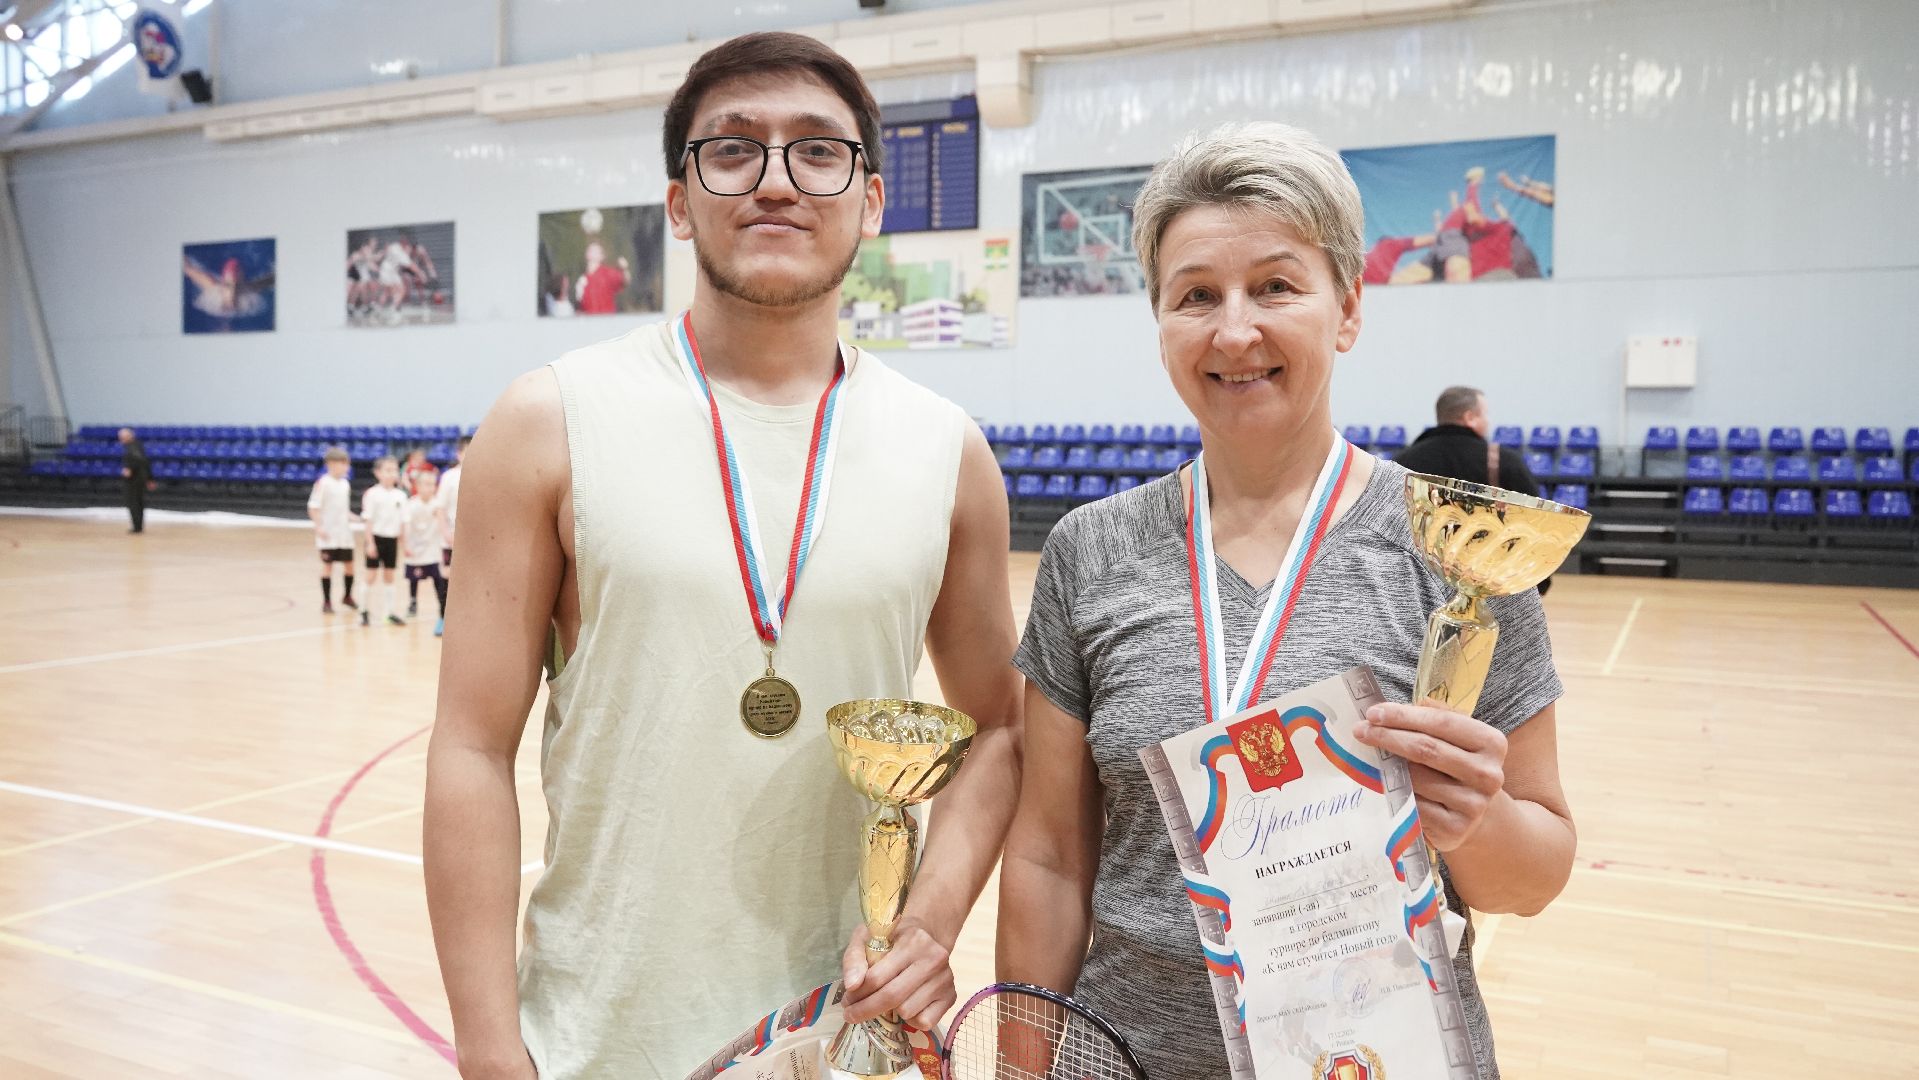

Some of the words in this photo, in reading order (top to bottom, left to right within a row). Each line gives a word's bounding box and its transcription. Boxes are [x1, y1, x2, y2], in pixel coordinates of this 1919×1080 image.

[1221, 788, 1363, 860] Грамота
[1255, 840, 1351, 878] НАГРАЖДАЕТСЯ
[1252, 904, 1296, 926] занявший
[1350, 884, 1378, 900] место
[1296, 911, 1347, 932] городском
[1269, 942, 1306, 959] турнире
[1308, 936, 1320, 947] по
[1322, 920, 1380, 944] бадминтону
[1277, 959, 1295, 972] нам
[1296, 949, 1338, 967] стучится
[1340, 937, 1373, 955] Новый
